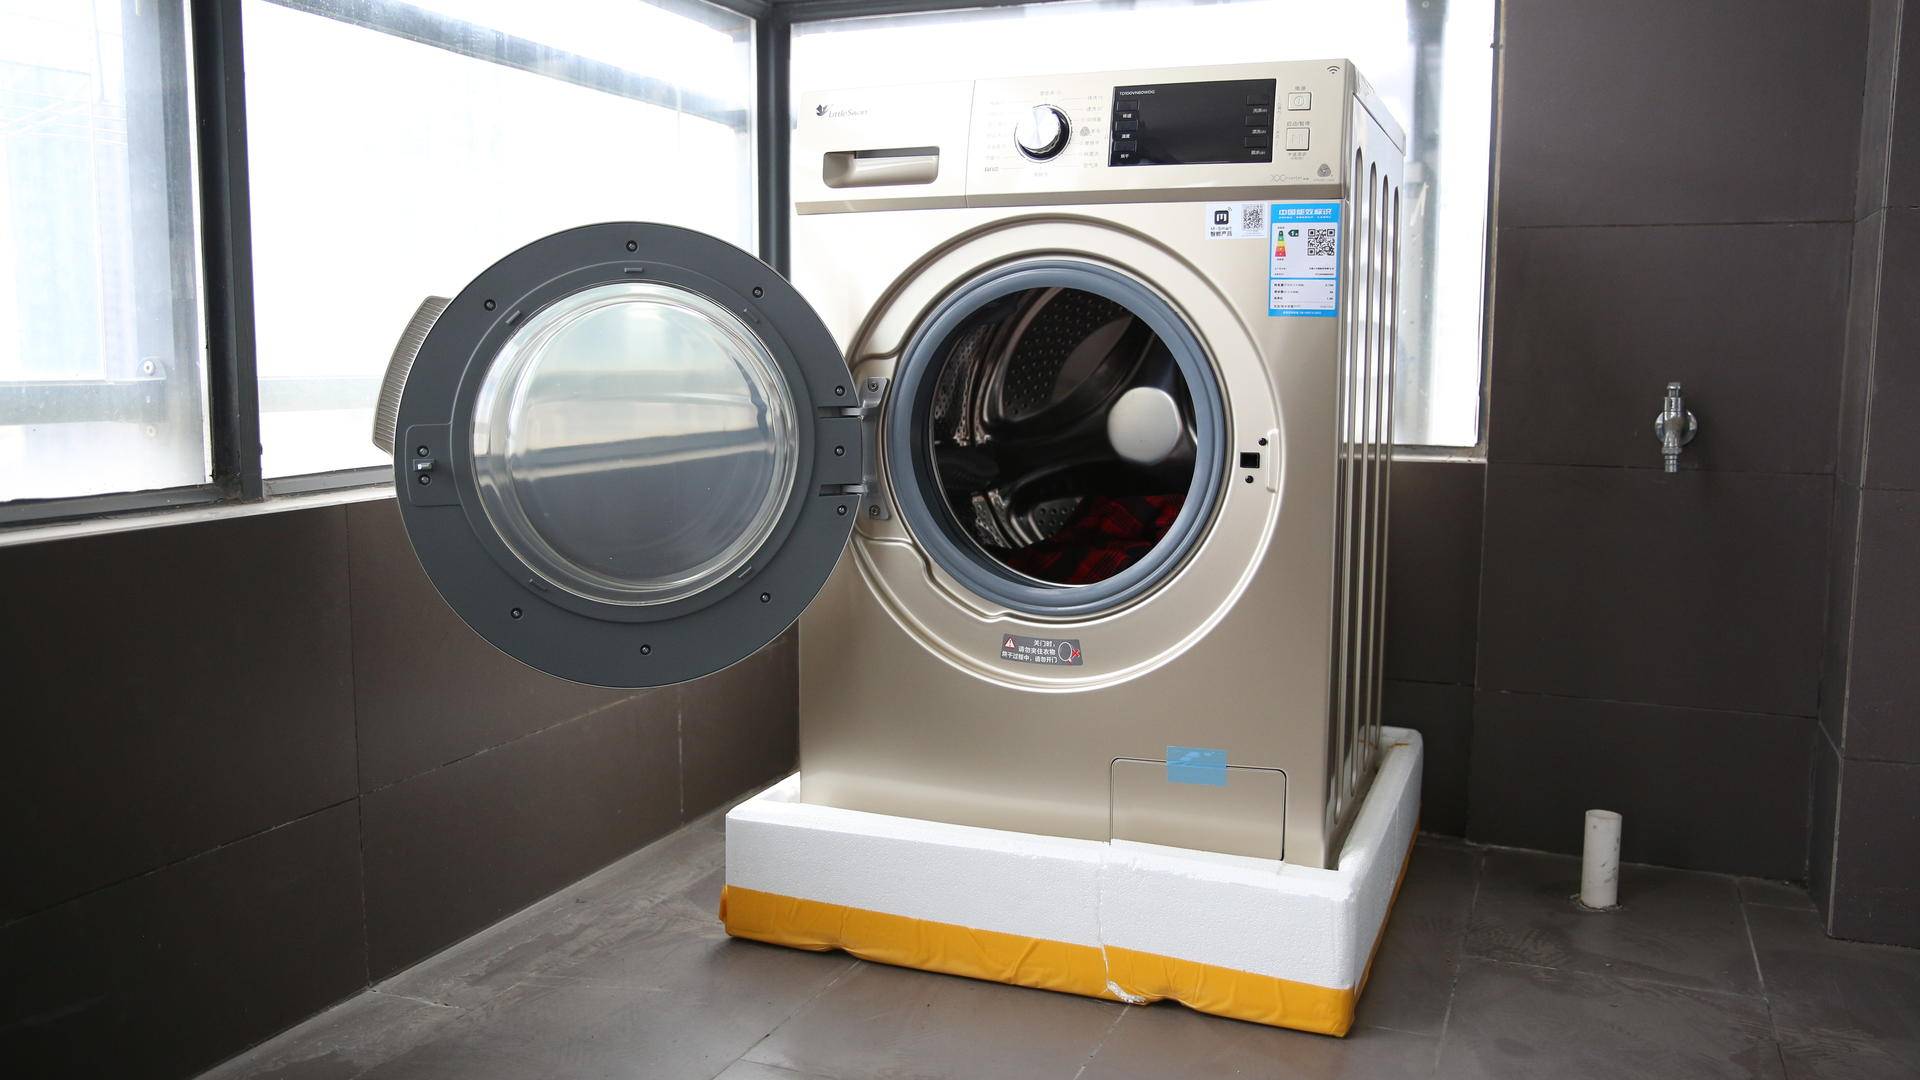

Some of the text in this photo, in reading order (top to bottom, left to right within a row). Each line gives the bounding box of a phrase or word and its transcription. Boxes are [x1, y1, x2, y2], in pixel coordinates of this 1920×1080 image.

[1278, 208, 1332, 216] 中国能效标识
[1018, 646, 1056, 655] 请勿夹住衣物
